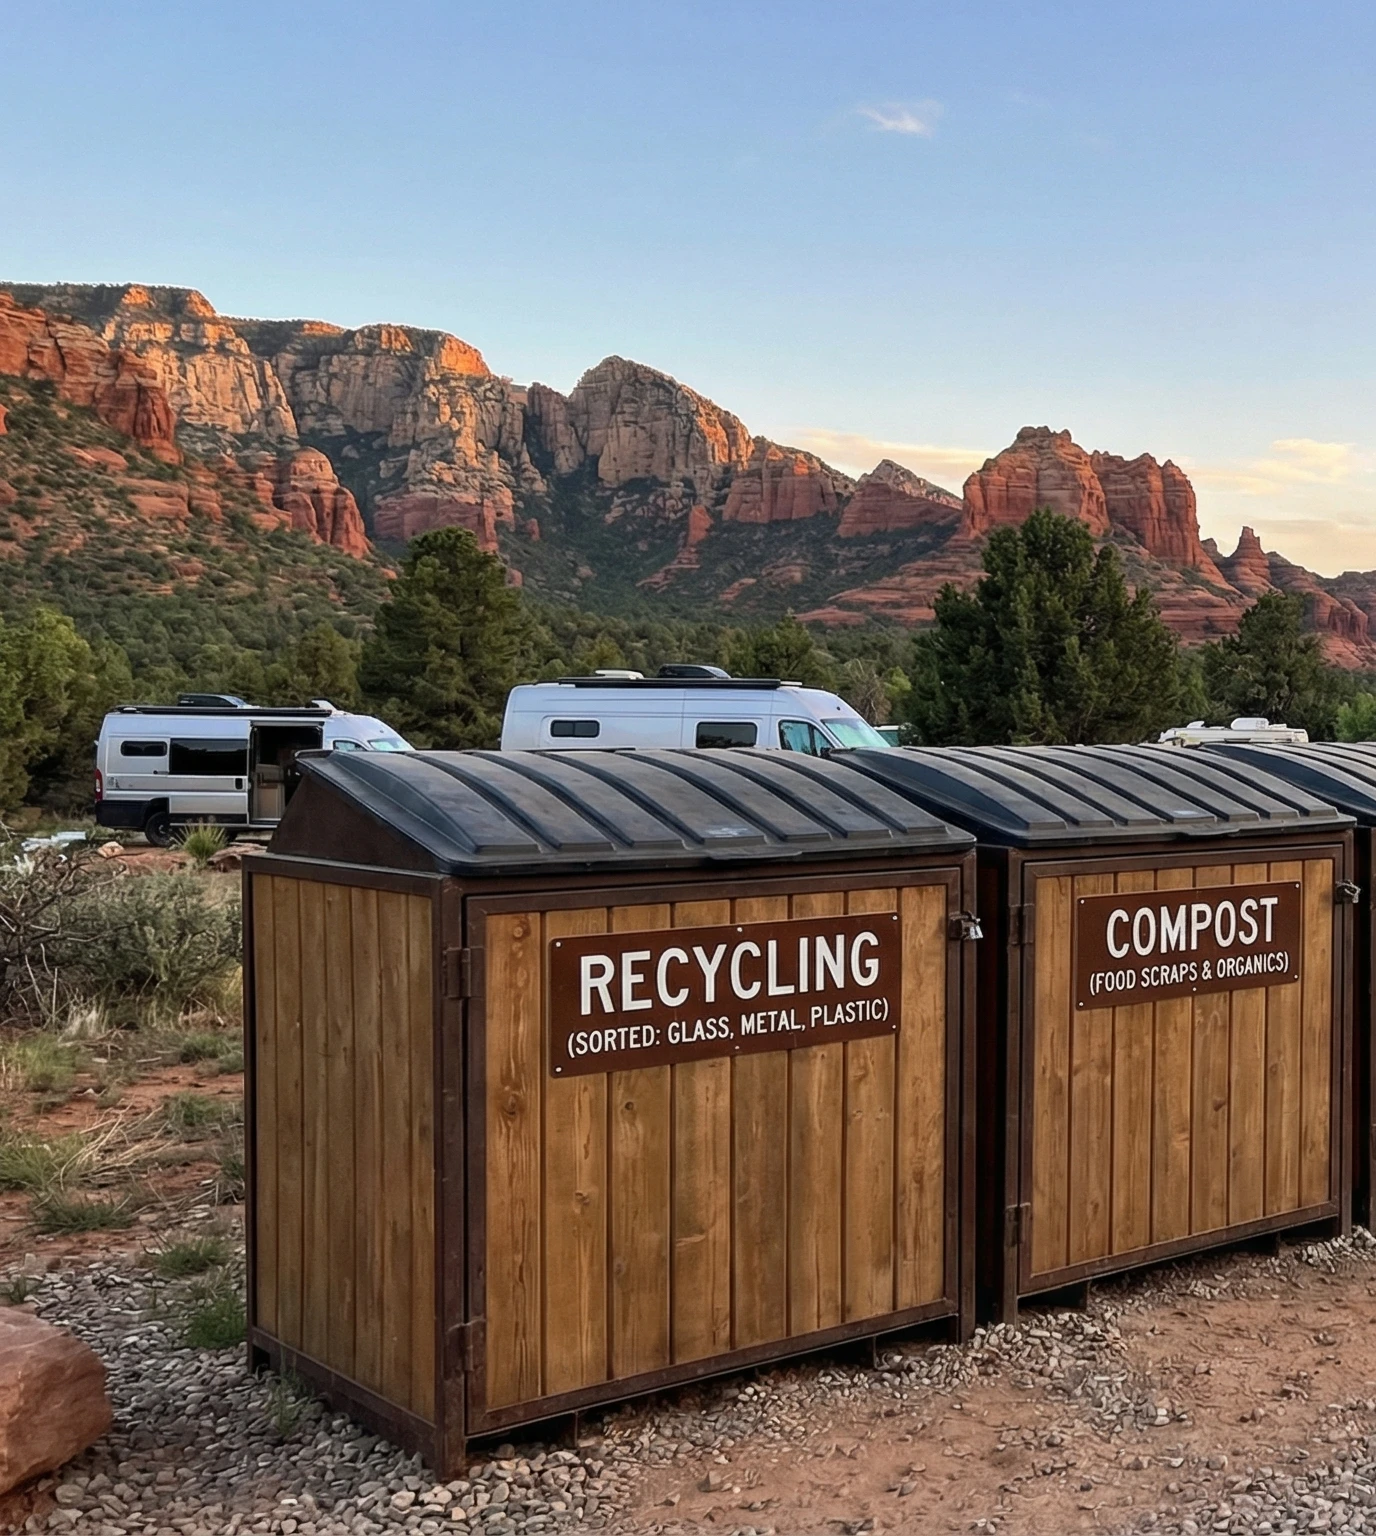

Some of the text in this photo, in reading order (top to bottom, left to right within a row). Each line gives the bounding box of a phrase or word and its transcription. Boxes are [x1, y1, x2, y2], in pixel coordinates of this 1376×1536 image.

[1106, 897, 1279, 959] COMPOST
[580, 931, 880, 1016] RECYCLING
[1089, 950, 1289, 996] (FOOD SCRAPS & ORGANICS)
[567, 996, 889, 1059] (SORTED: GLASS, METAL, PLASTIC)
